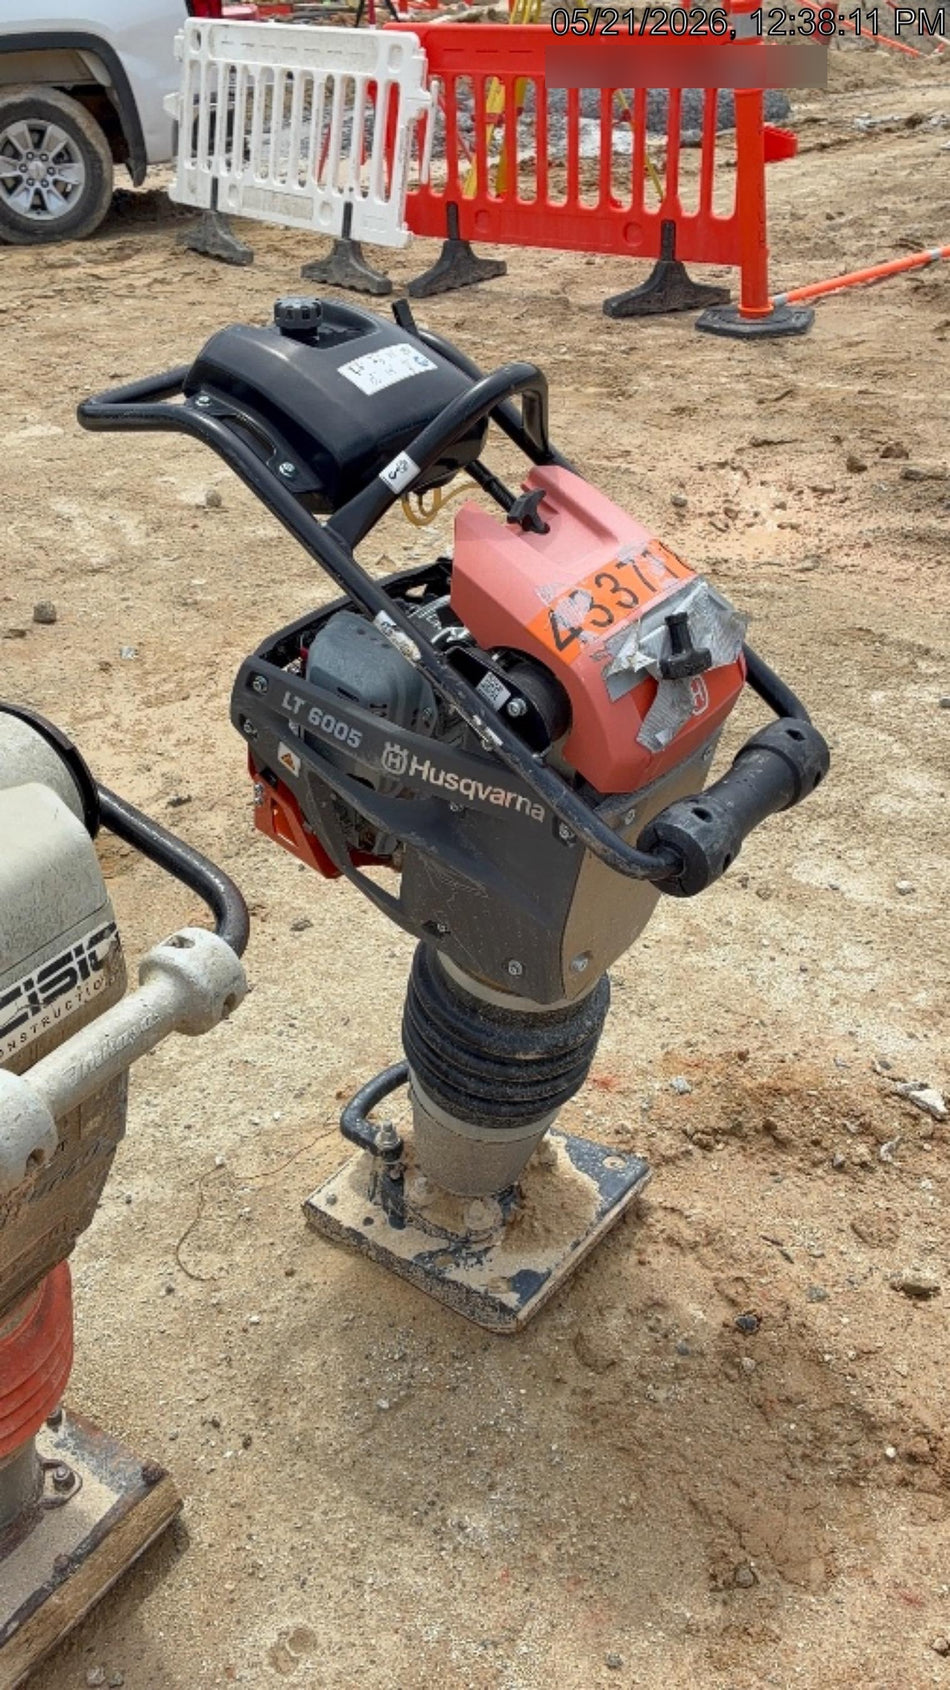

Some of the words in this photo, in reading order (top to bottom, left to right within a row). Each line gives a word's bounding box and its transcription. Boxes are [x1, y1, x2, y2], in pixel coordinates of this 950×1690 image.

[281, 691, 305, 714] LT
[308, 707, 363, 748] 6005
[409, 754, 545, 823] Husqvarna
